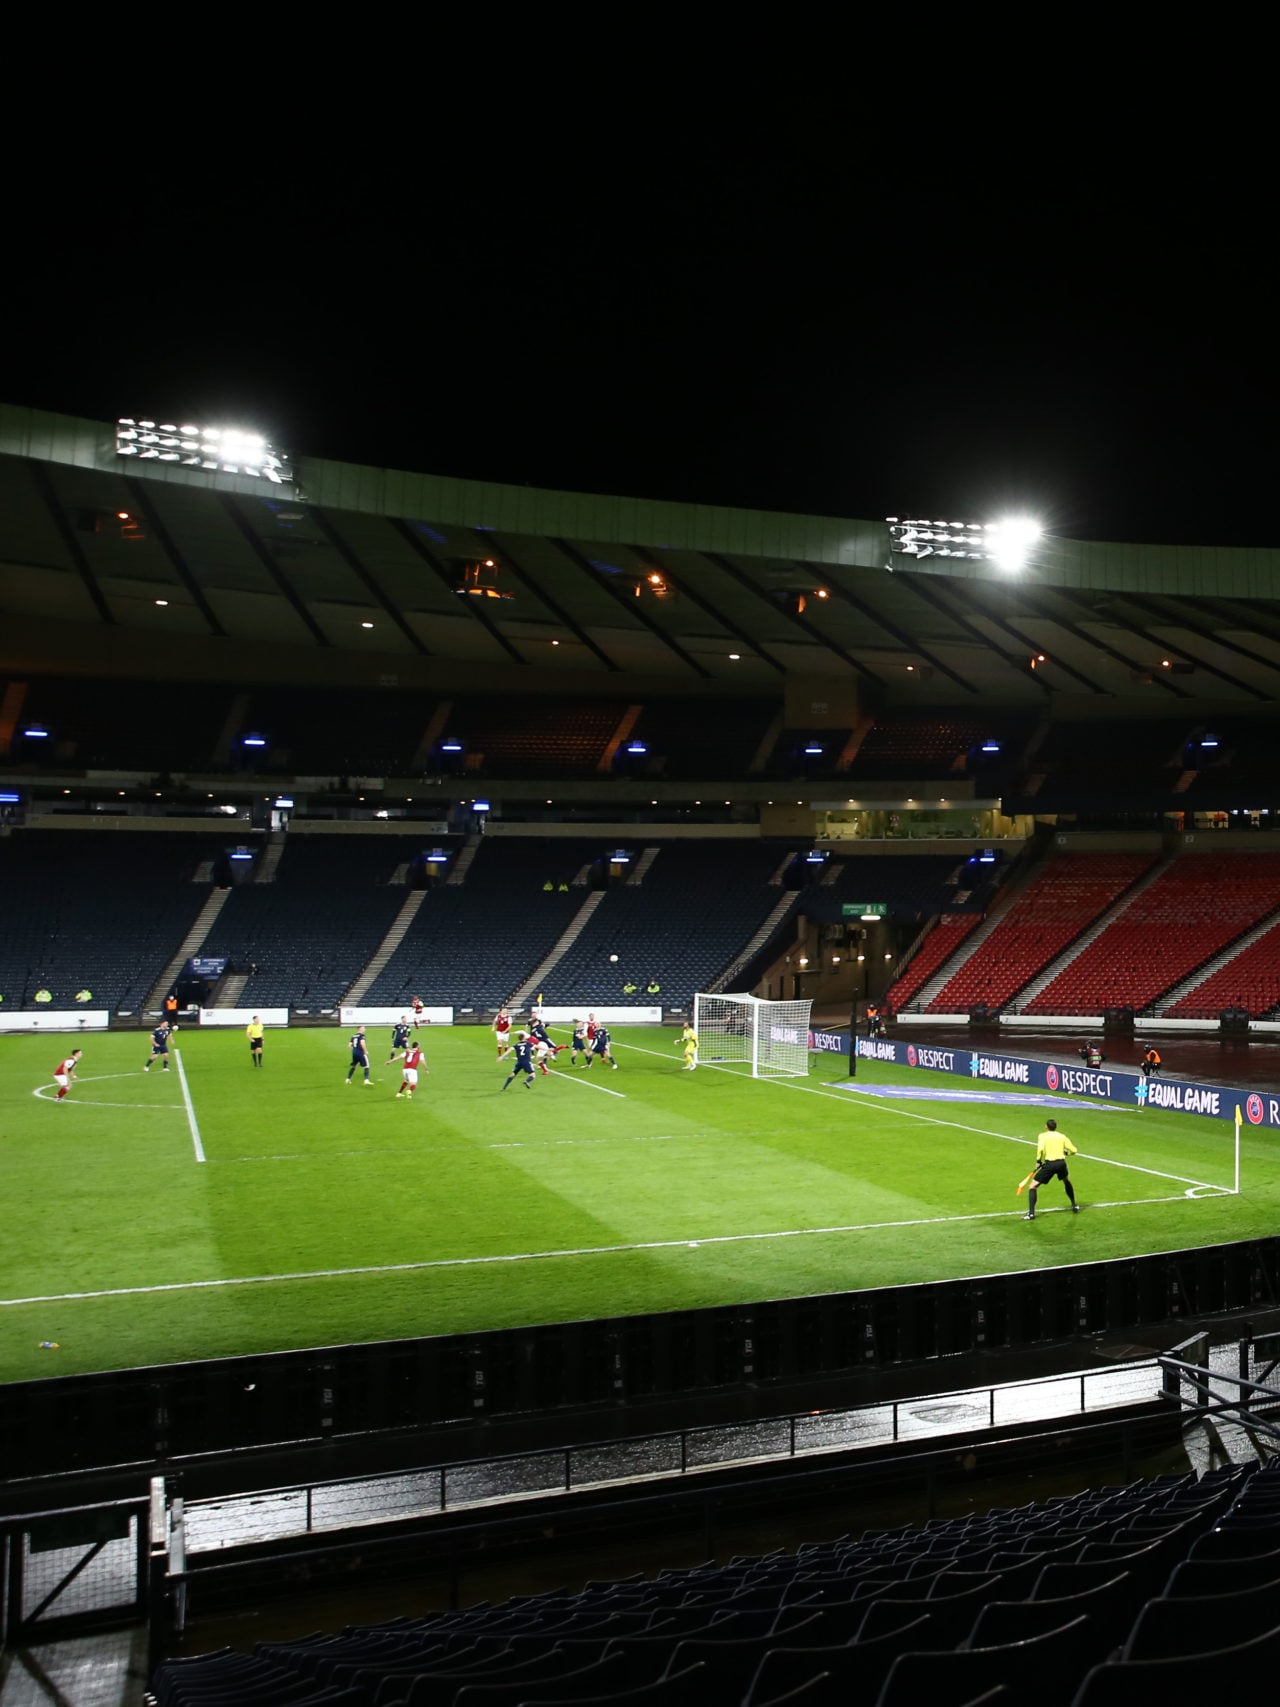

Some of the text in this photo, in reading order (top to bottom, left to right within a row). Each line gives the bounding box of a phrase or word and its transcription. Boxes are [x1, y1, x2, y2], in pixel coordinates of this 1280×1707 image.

[519, 1045, 526, 1056] 2
[814, 1032, 842, 1052] RESPECT
[918, 1048, 955, 1071] RESPECT
[1061, 1069, 1113, 1097] RESPECT
